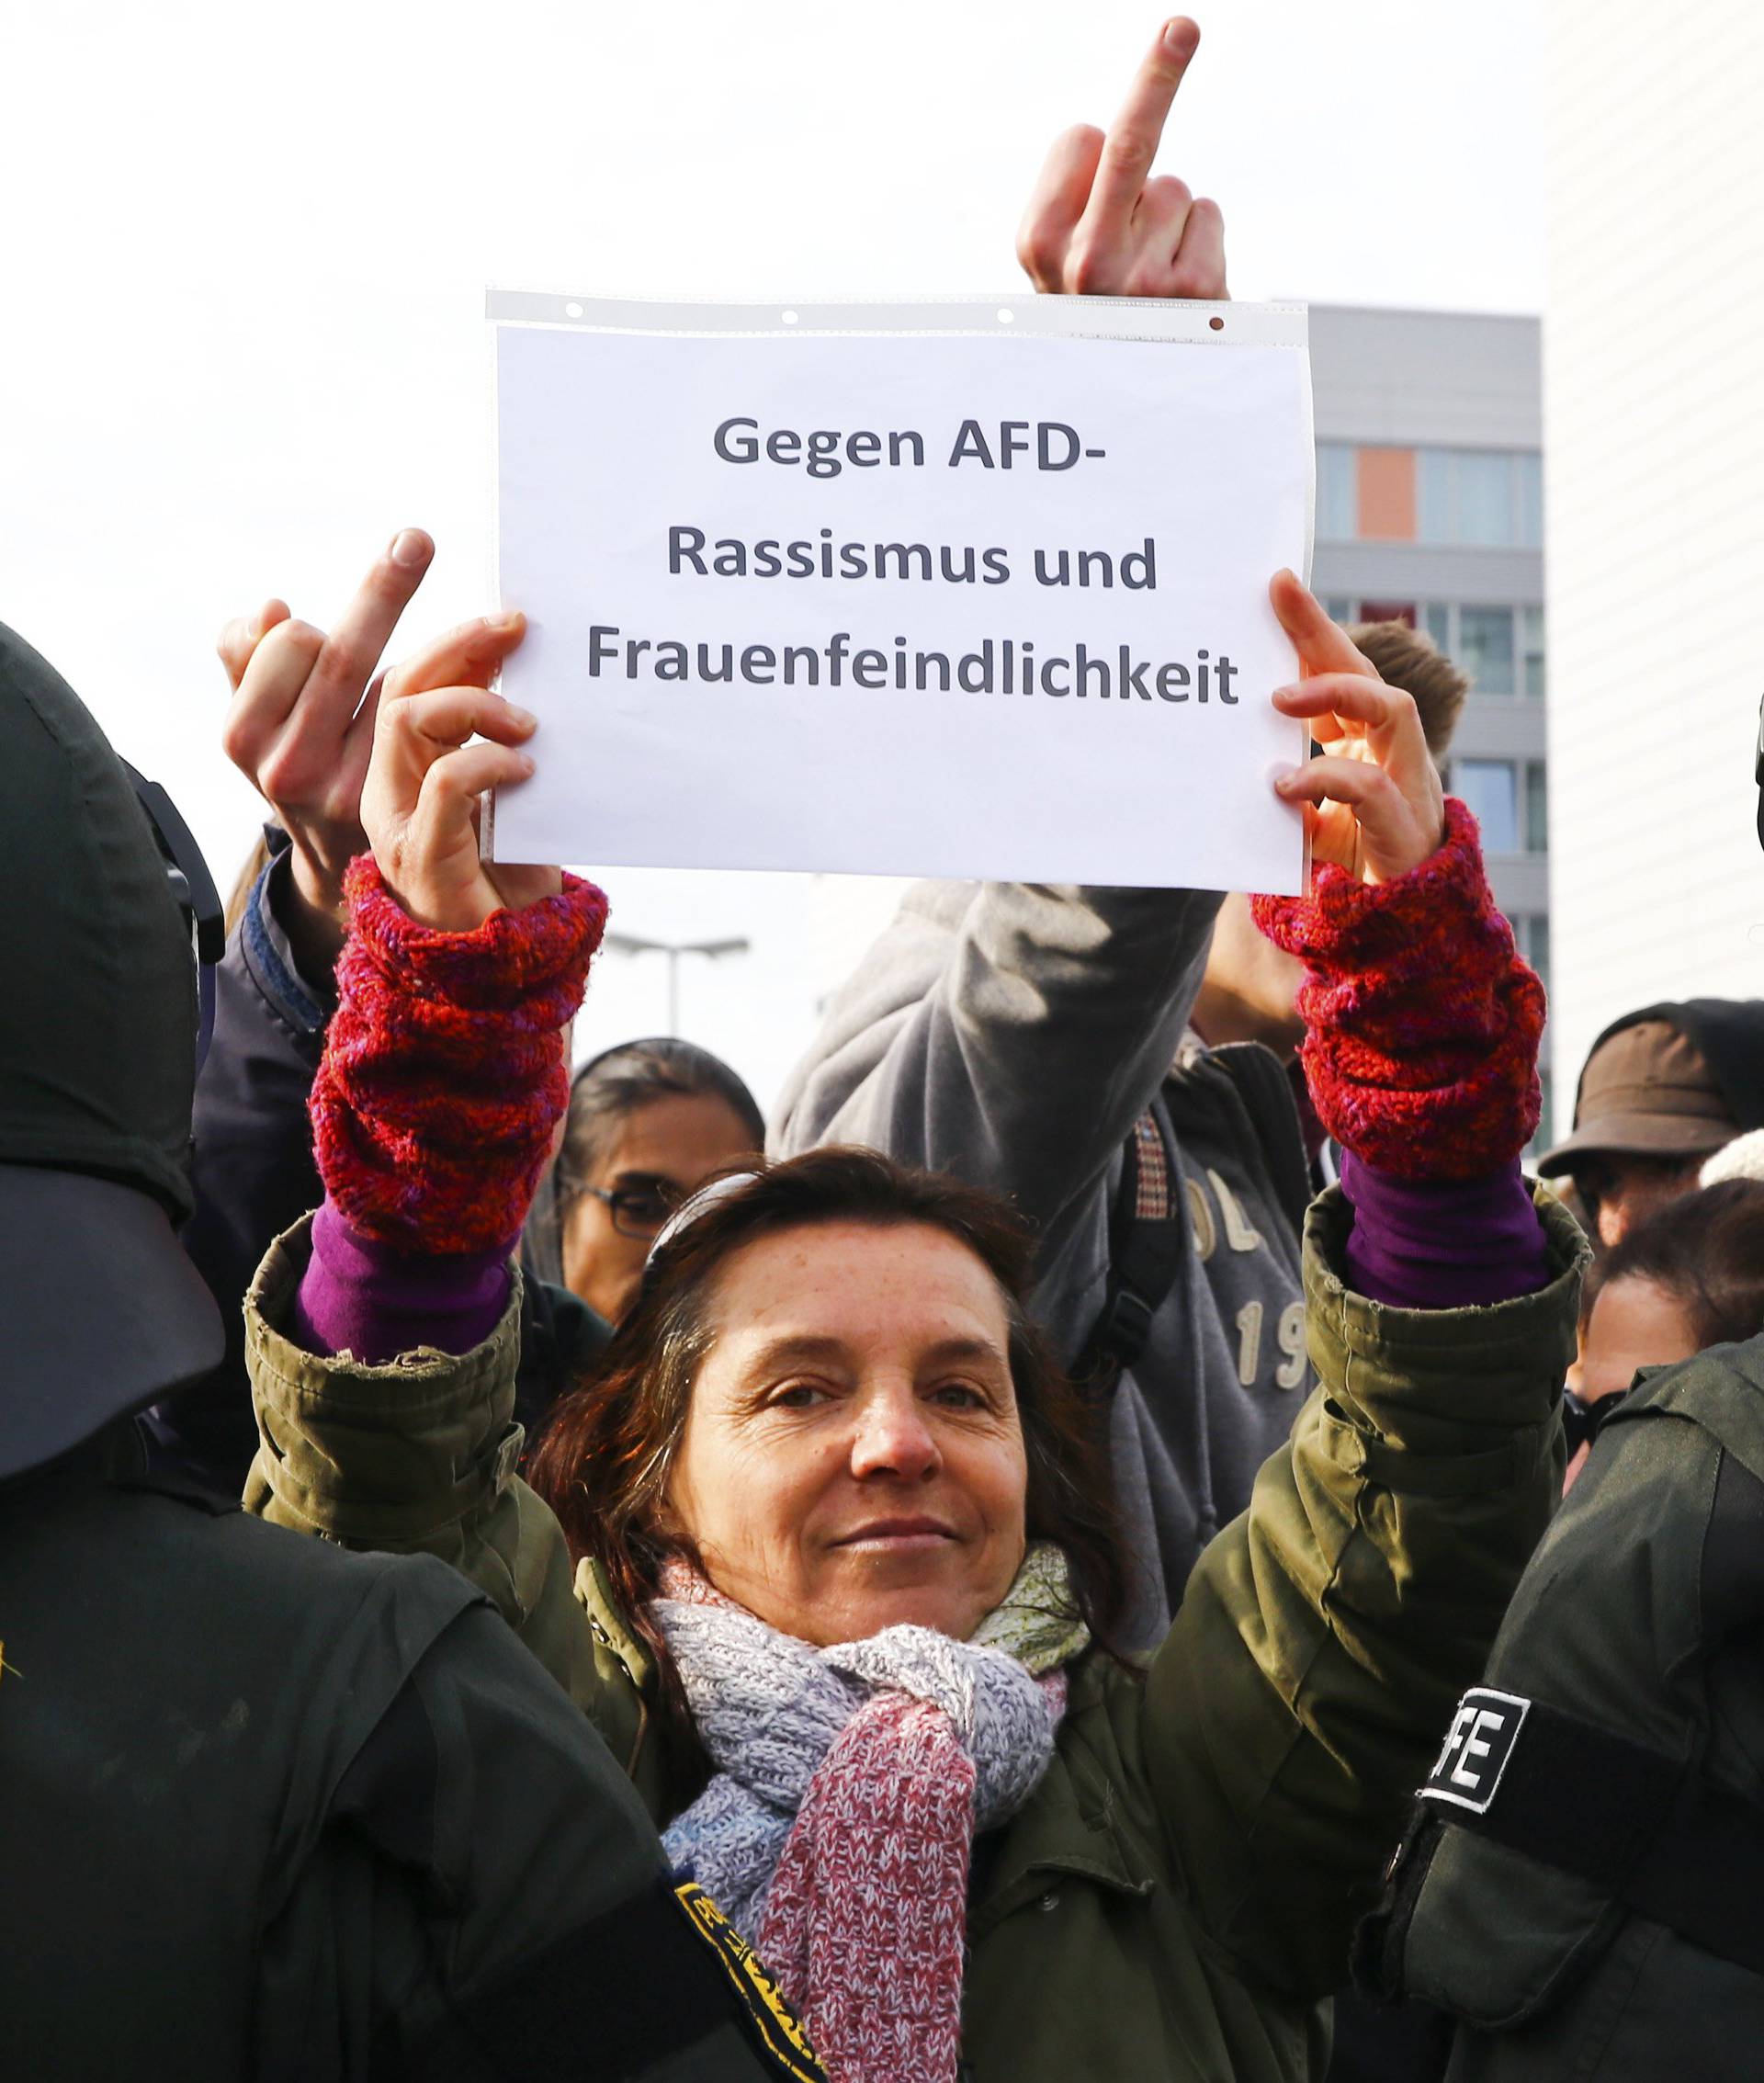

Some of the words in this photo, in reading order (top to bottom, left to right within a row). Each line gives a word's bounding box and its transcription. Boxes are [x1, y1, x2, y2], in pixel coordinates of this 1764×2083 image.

[713, 417, 924, 479] Gegen
[948, 419, 1107, 471] AFD-
[668, 526, 1012, 585] Rassismus
[1034, 538, 1157, 590] und
[588, 625, 1240, 705] Frauenfeindlichkeit
[1235, 1299, 1308, 1390] 19
